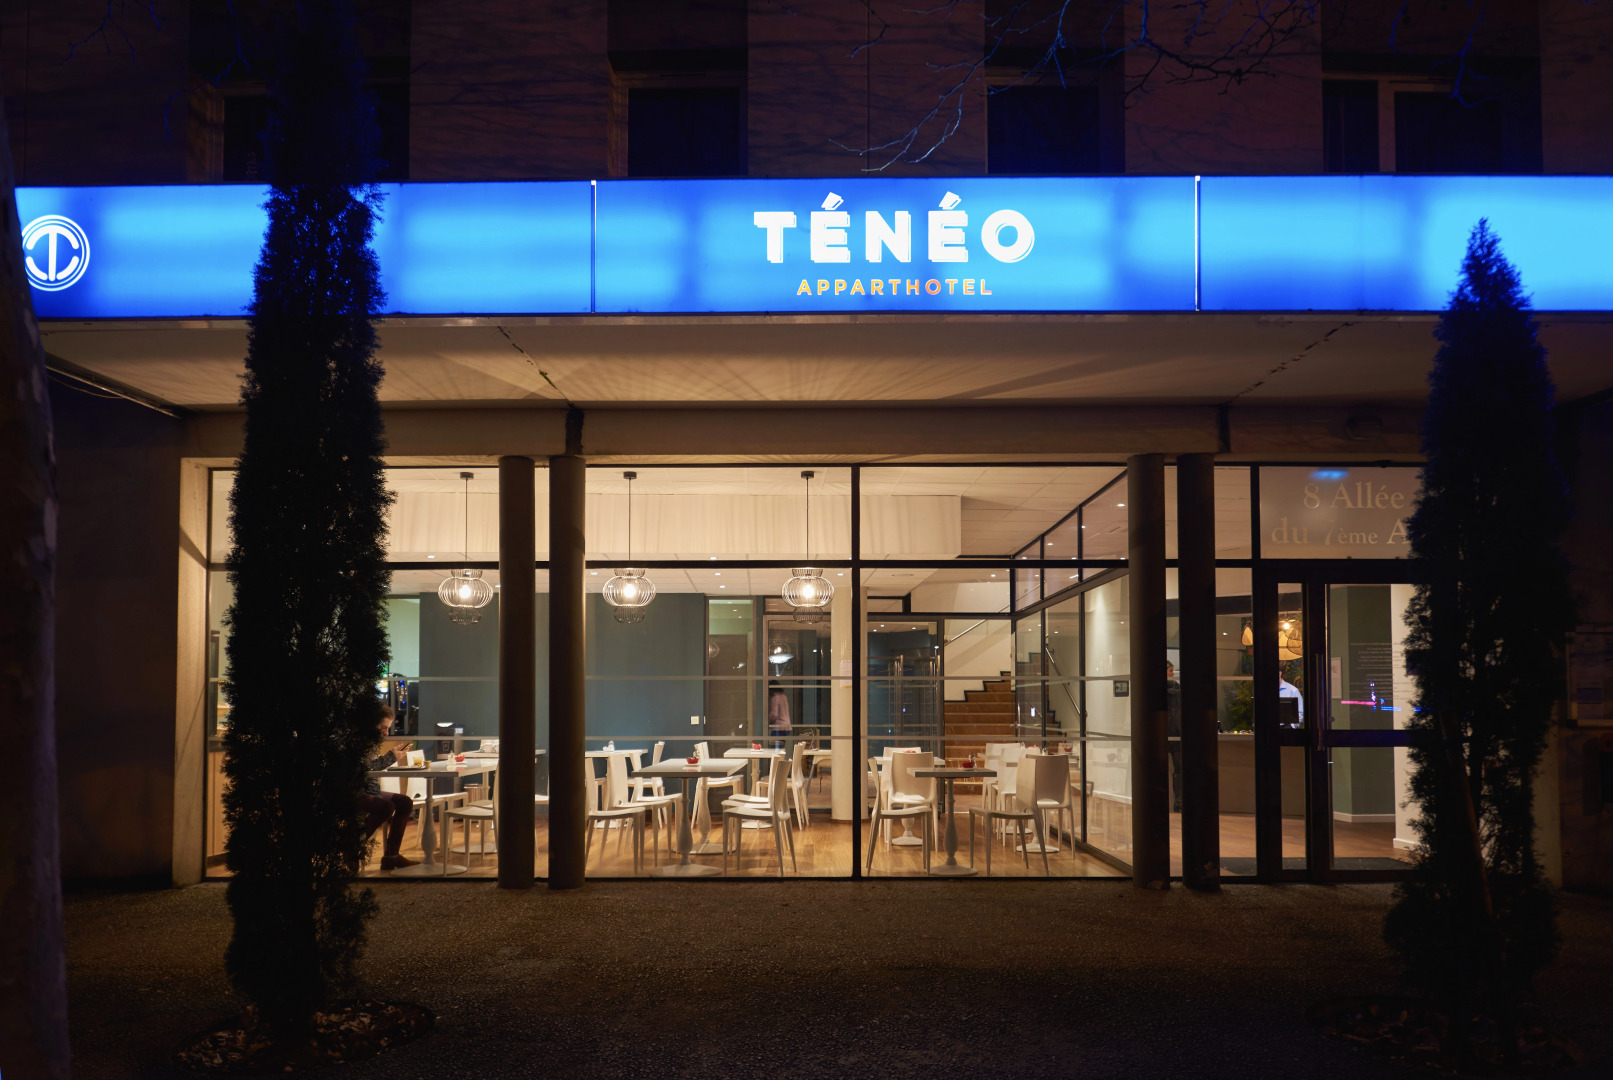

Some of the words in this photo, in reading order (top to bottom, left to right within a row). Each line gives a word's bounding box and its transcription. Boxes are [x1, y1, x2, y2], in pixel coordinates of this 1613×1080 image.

[753, 191, 1035, 263] TÉNÉO
[796, 278, 993, 296] APPARTHOTEL
[1303, 483, 1320, 509] 8
[1329, 481, 1405, 510] Allée
[1271, 516, 1310, 544] du
[1322, 519, 1378, 546] 7ème
